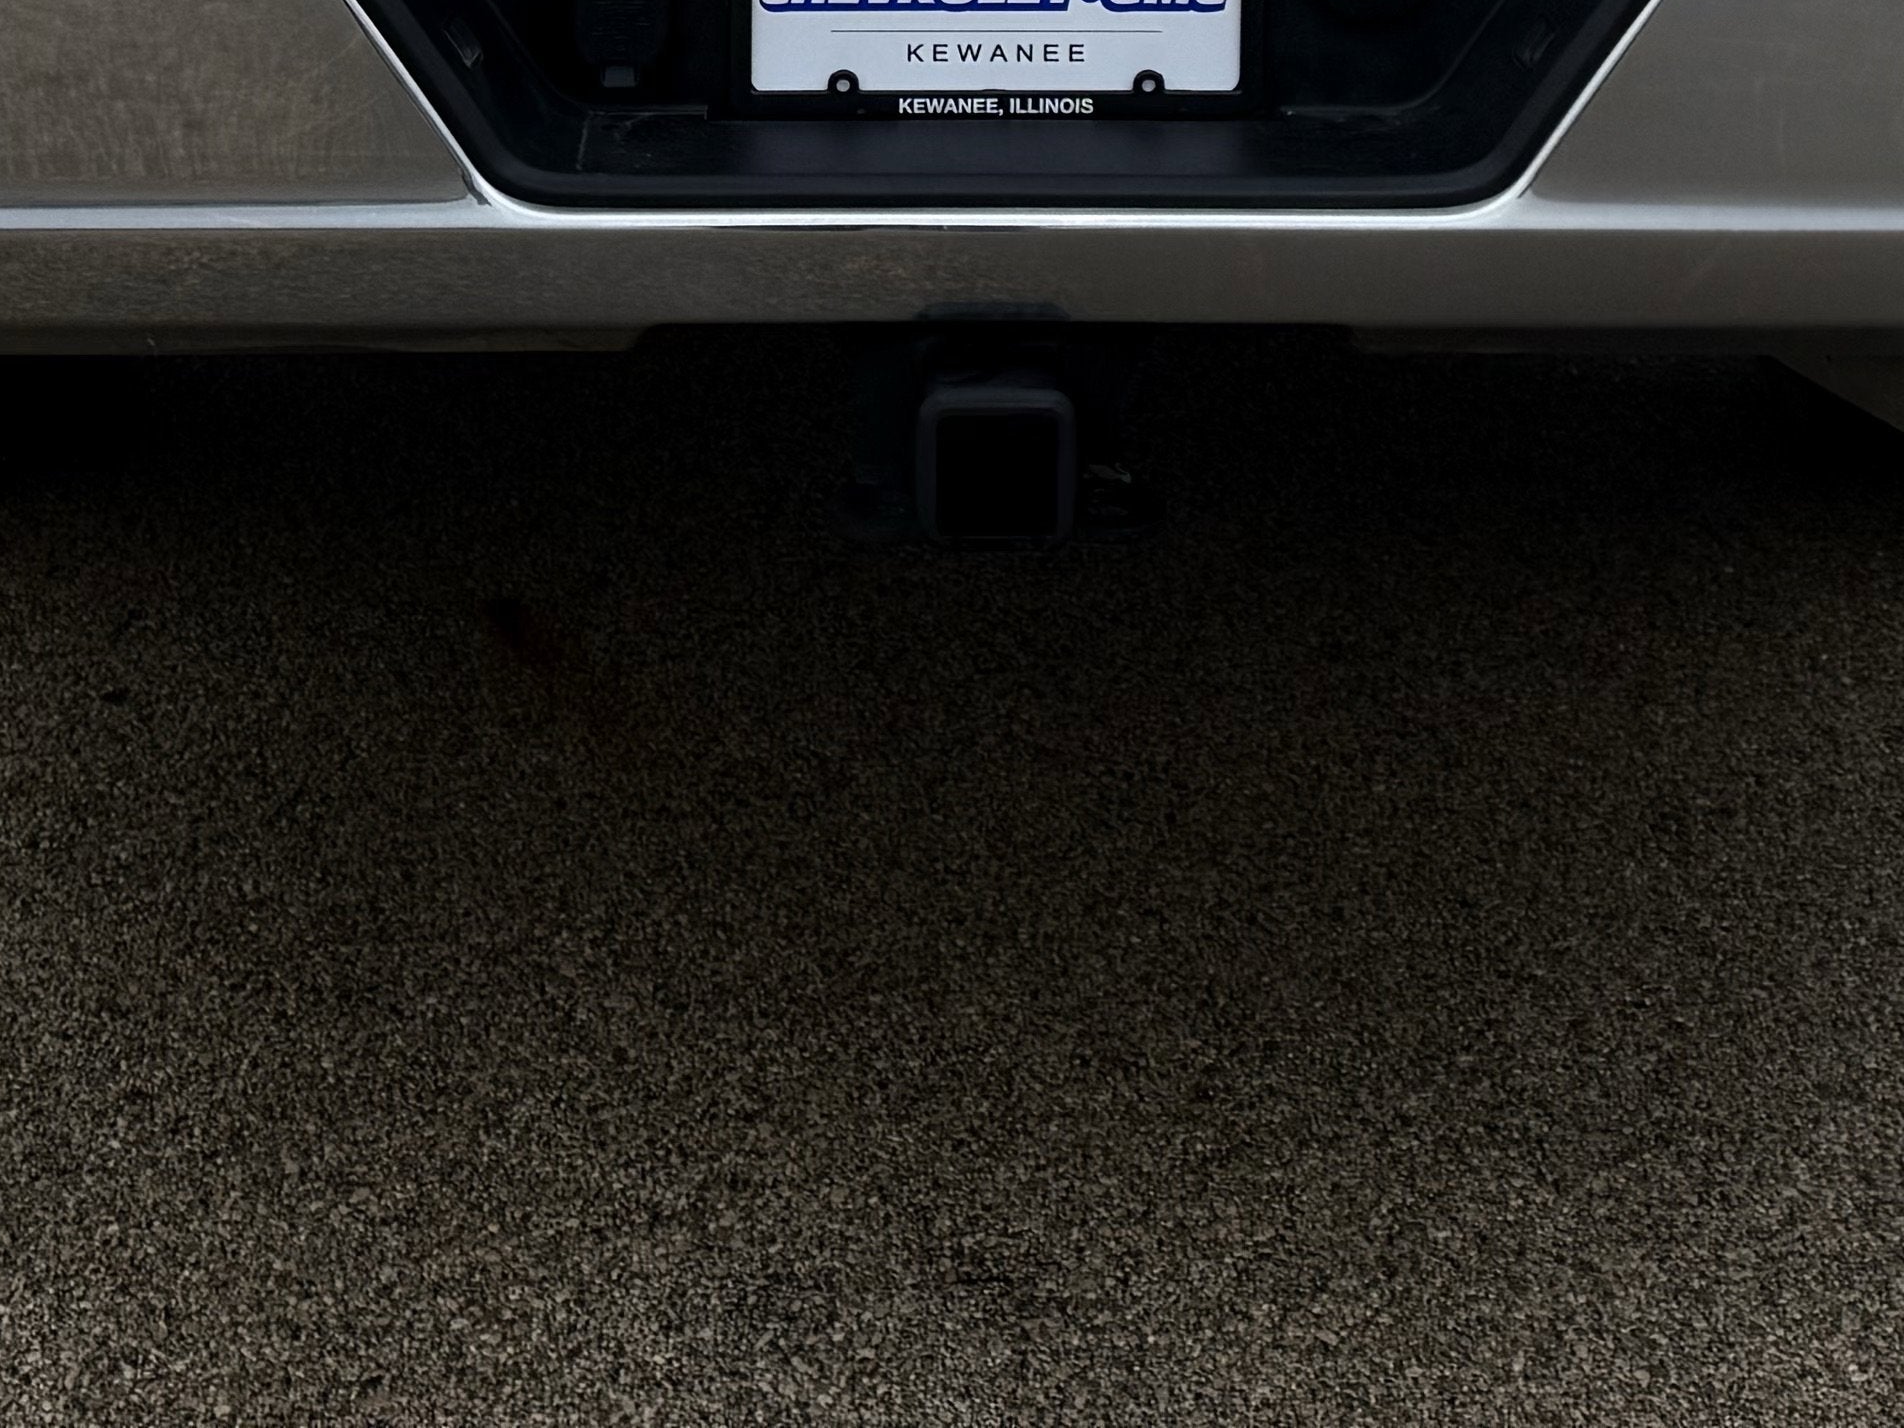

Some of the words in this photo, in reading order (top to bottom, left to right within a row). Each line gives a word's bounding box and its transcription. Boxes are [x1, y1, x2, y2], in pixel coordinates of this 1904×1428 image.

[906, 44, 1086, 62] KEWANEE
[898, 98, 1004, 117] KEWANEE,
[1009, 98, 1094, 114] ILLINOIS
